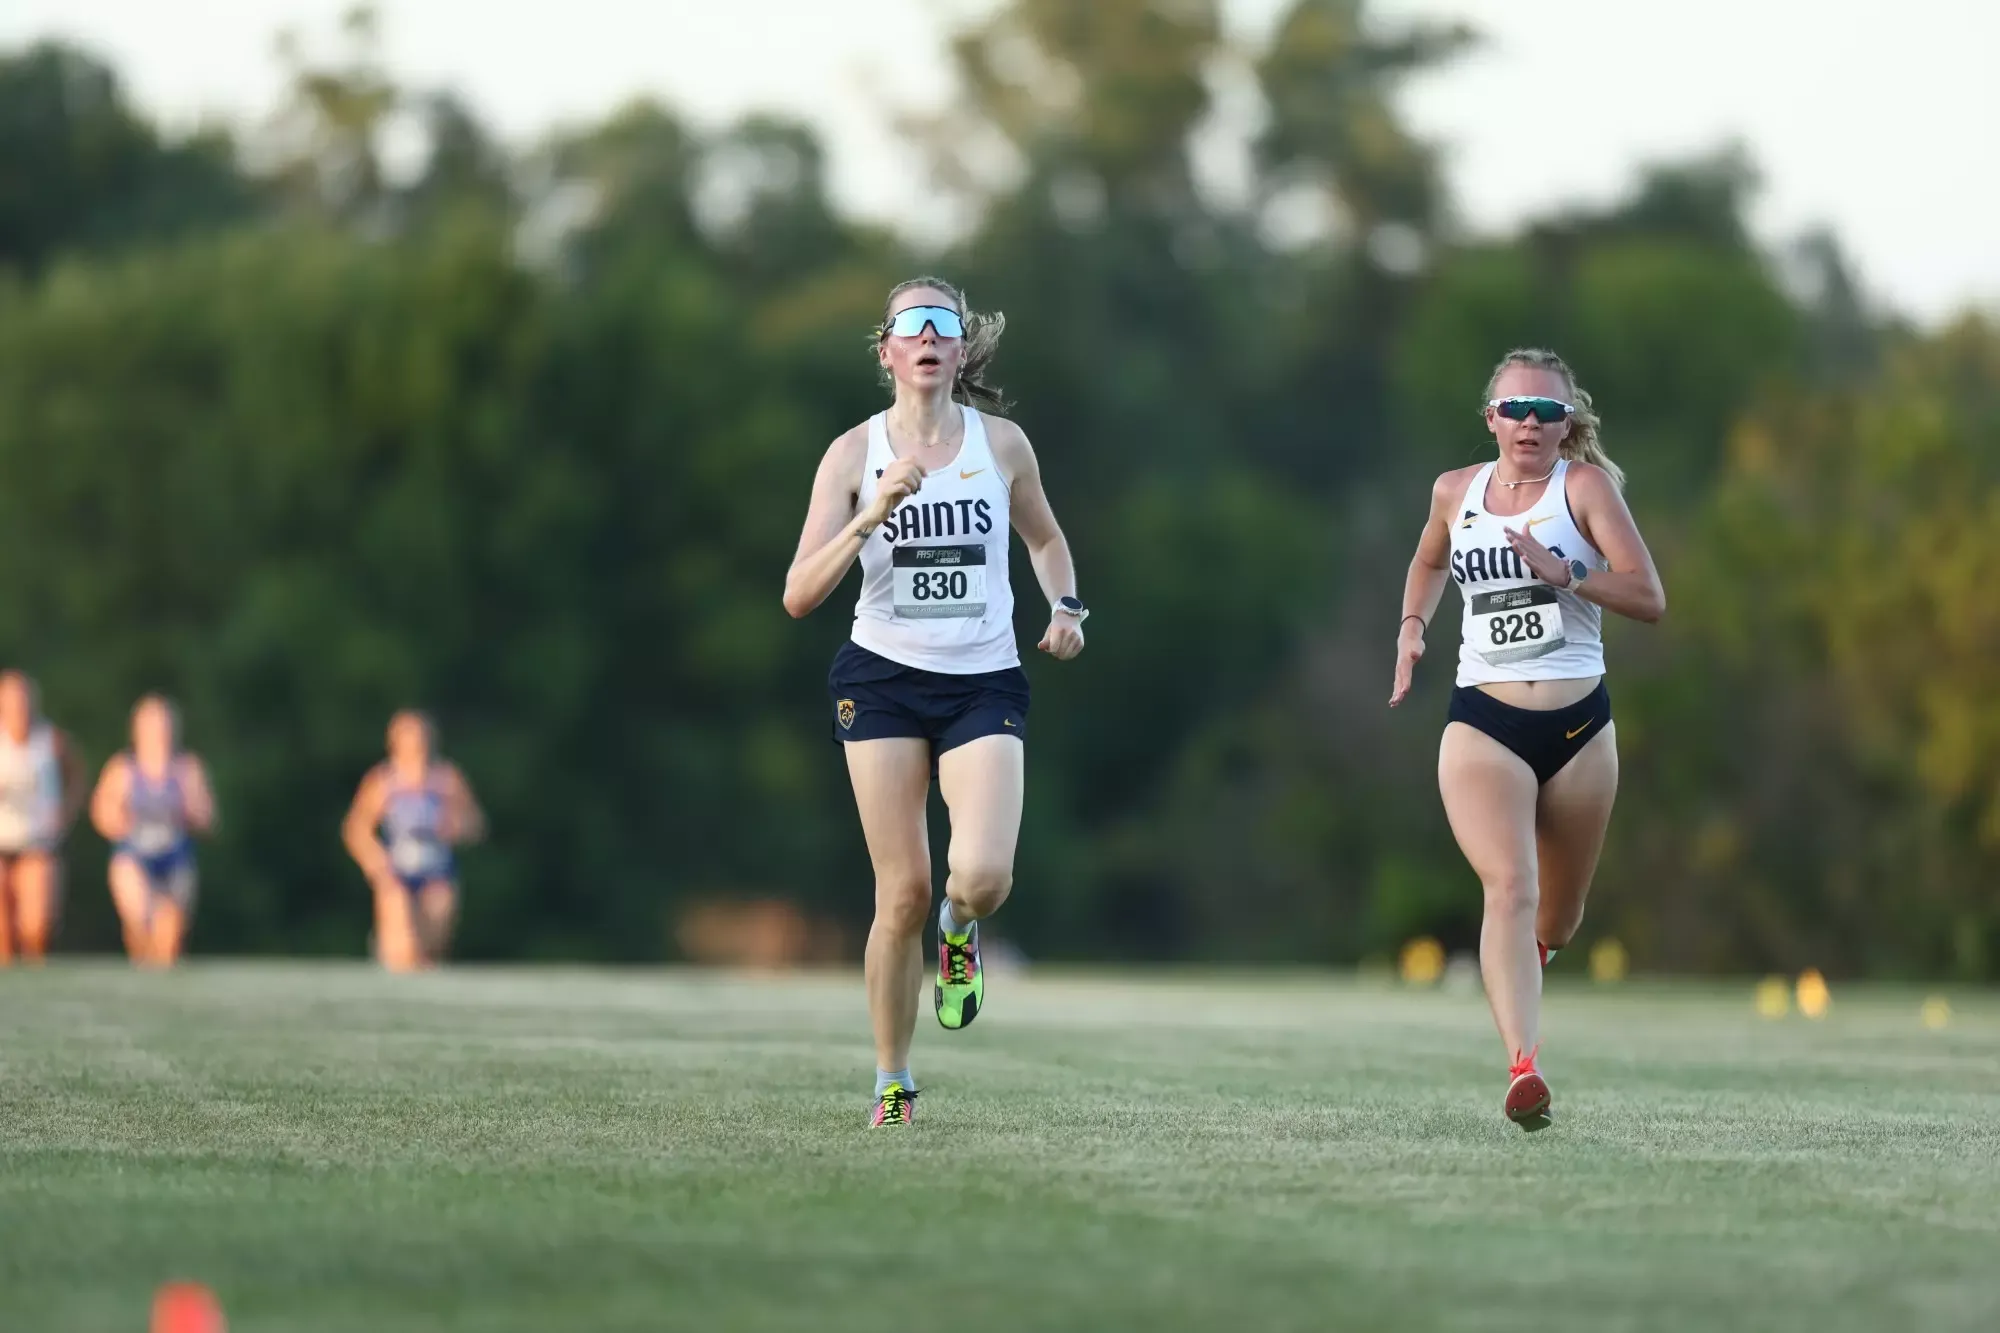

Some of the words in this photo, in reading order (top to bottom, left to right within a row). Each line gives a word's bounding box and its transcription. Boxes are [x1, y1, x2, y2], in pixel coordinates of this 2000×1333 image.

[883, 498, 992, 543] SAINTS
[916, 550, 936, 559] FAST
[1452, 545, 1566, 584] SAIN
[912, 570, 968, 601] 830
[1490, 593, 1507, 604] FAST
[1489, 611, 1544, 645] 828
